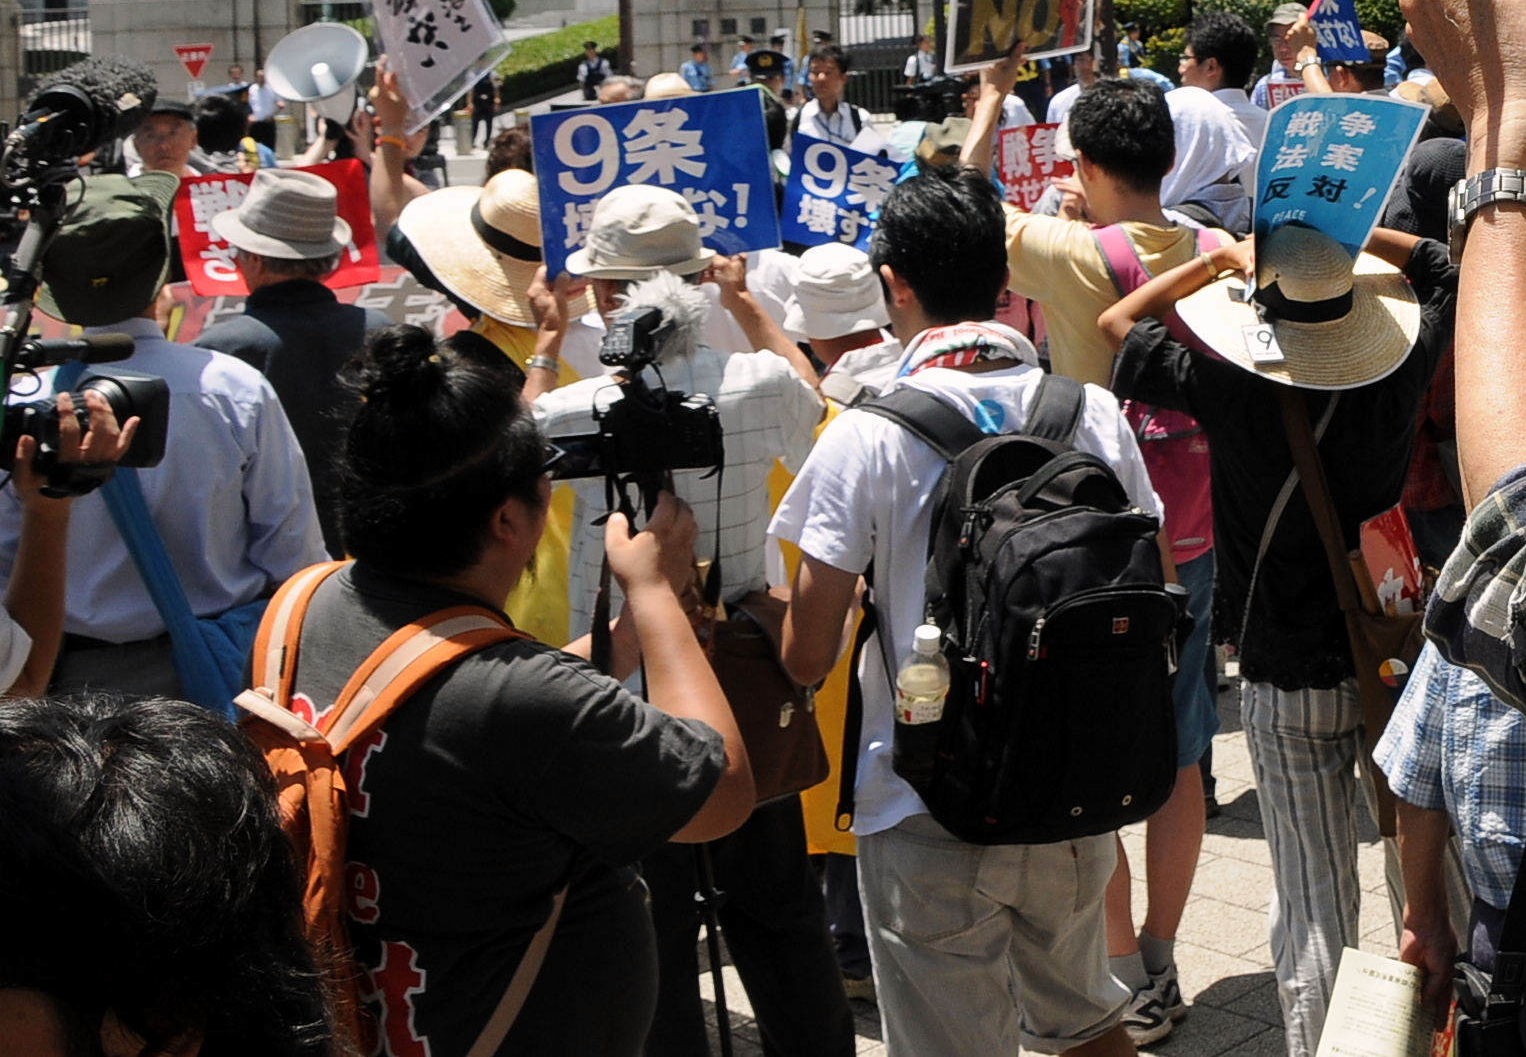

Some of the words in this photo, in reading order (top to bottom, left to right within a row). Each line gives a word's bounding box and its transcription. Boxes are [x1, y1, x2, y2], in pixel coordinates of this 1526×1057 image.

[1284, 110, 1377, 138] 戦争
[553, 107, 707, 196] 9条
[1270, 143, 1365, 172] 法案
[801, 143, 898, 214] 9条
[1261, 175, 1377, 210] 反対!
[797, 194, 877, 243] 壊す
[1271, 209, 1307, 224] PEACE
